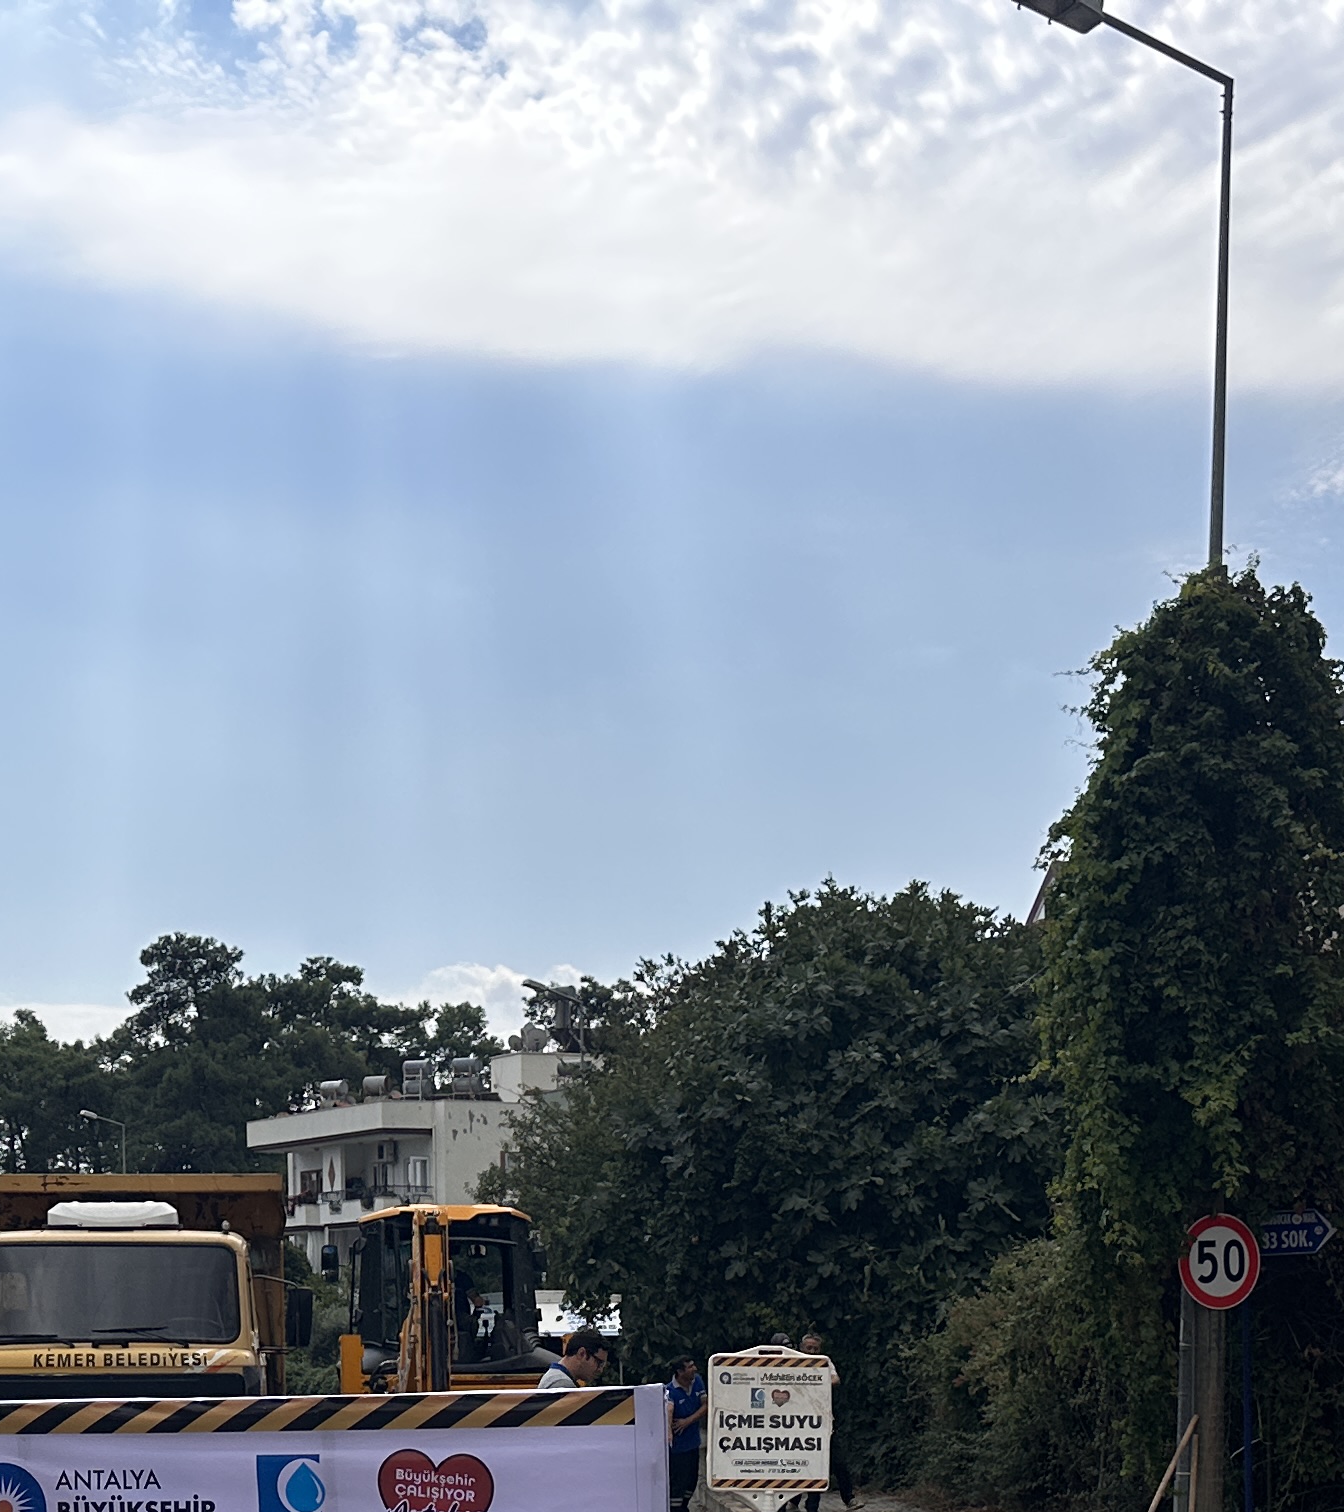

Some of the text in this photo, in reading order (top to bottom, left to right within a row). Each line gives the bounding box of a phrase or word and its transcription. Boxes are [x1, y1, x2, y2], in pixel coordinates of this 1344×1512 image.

[1281, 1229, 1314, 1249] SOK.
[1197, 1239, 1245, 1284] 50
[33, 1353, 96, 1367] KEMER
[719, 1411, 822, 1431] İÇME SUYU
[719, 1436, 822, 1453] ÇALIŞMASI
[56, 1469, 162, 1491] ANTALYA
[395, 1468, 476, 1488] Büyükşehir
[394, 1484, 476, 1503] ÇALIŞIYOR
